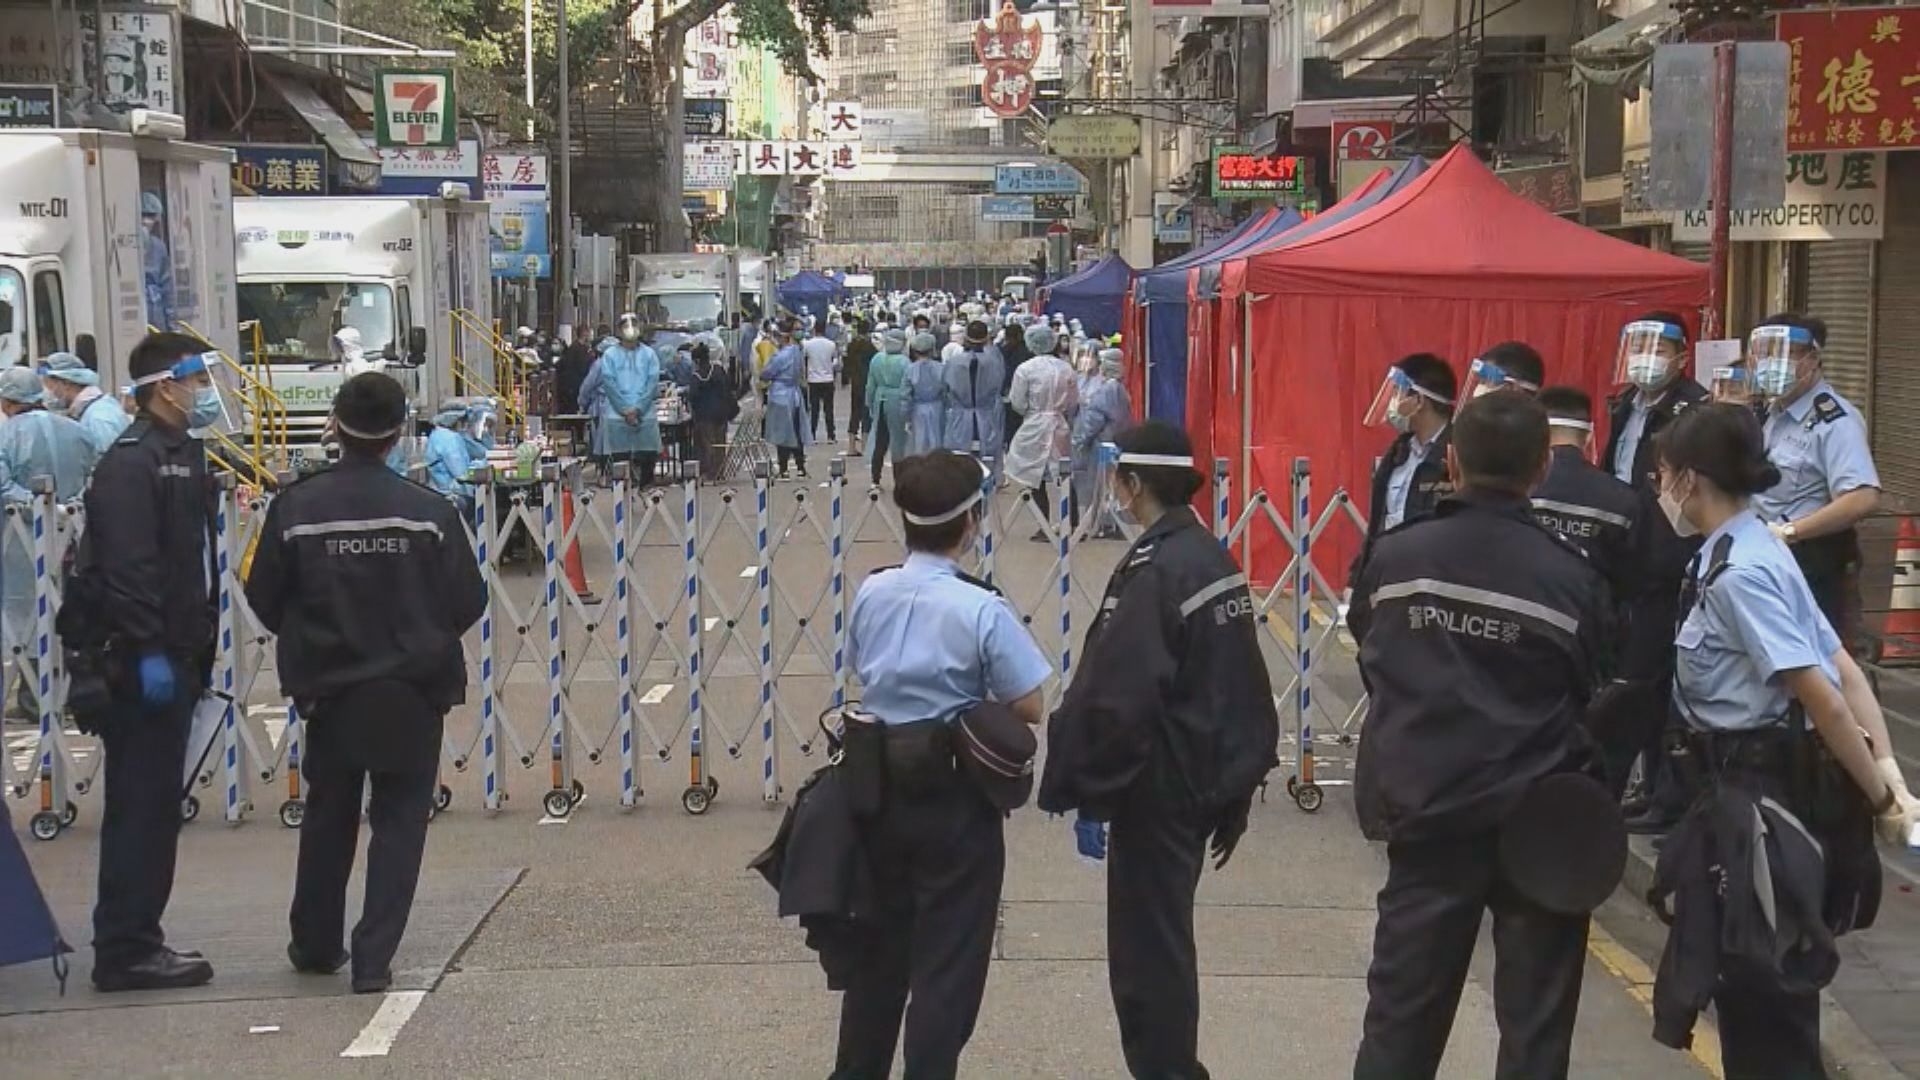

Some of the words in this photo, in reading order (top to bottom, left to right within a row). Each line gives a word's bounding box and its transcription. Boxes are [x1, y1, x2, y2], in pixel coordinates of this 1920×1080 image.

[393, 82, 438, 145] 7
[831, 106, 858, 131] 大
[266, 158, 321, 191] 藥業
[19, 198, 69, 218] MTC-01
[1749, 203, 1846, 226] PROPERTY
[1848, 203, 1879, 225] CO.
[338, 537, 399, 554] POLICE
[1423, 606, 1500, 640] POLICE
